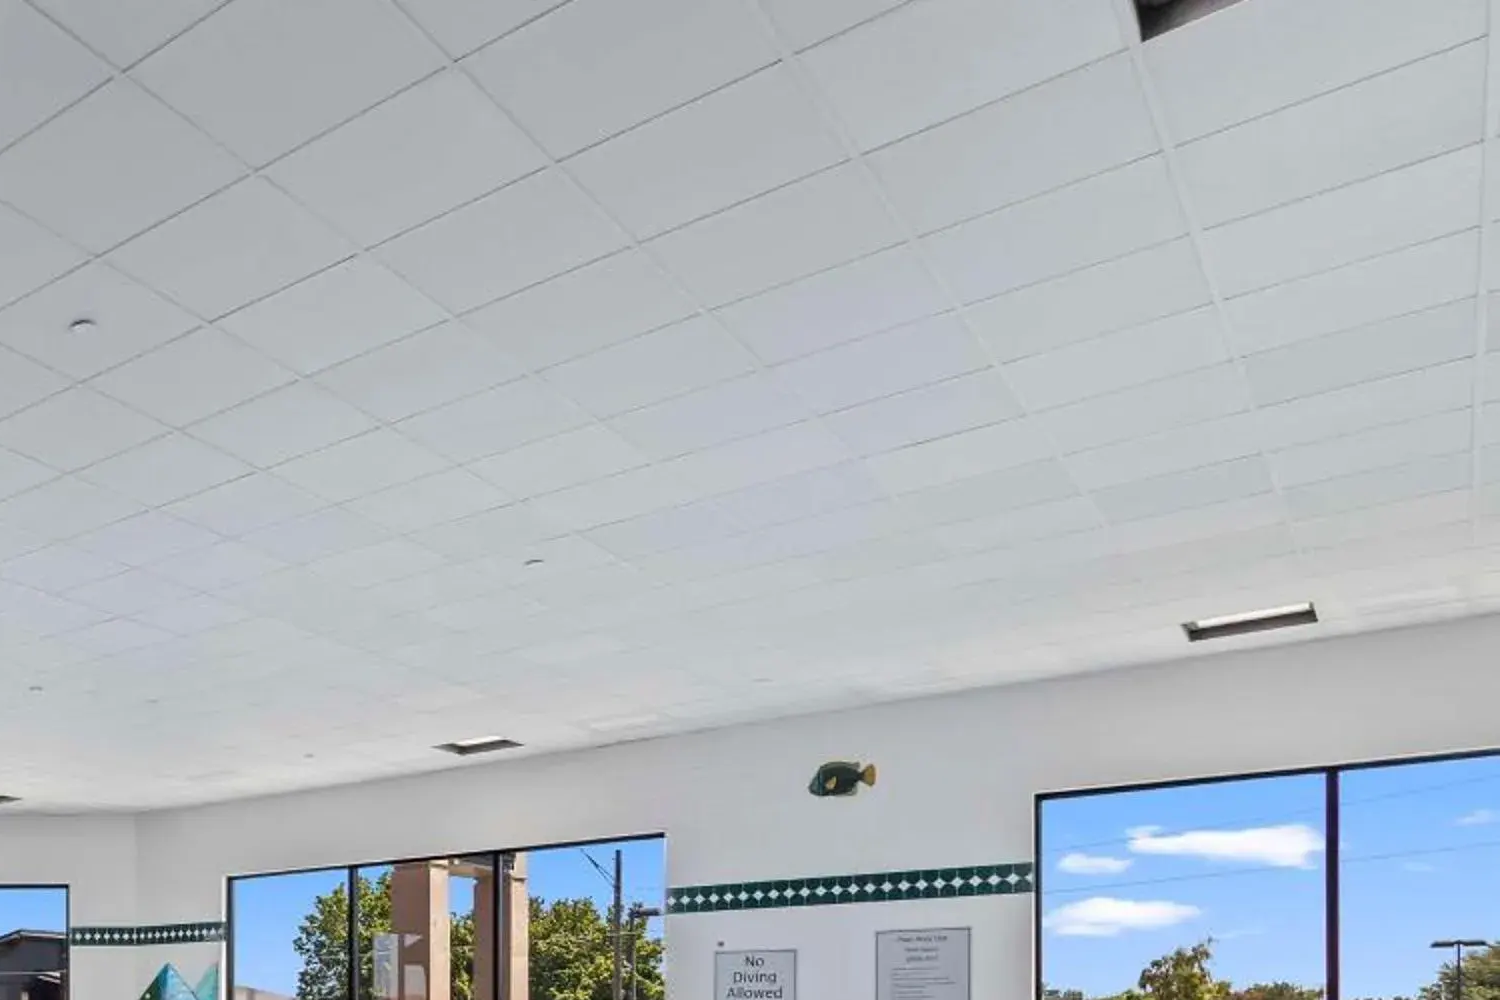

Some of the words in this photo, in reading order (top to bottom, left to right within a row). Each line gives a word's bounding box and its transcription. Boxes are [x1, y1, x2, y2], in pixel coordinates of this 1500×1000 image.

[745, 956, 765, 967] No
[733, 972, 777, 985] Diving
[726, 985, 783, 999] Allowed
